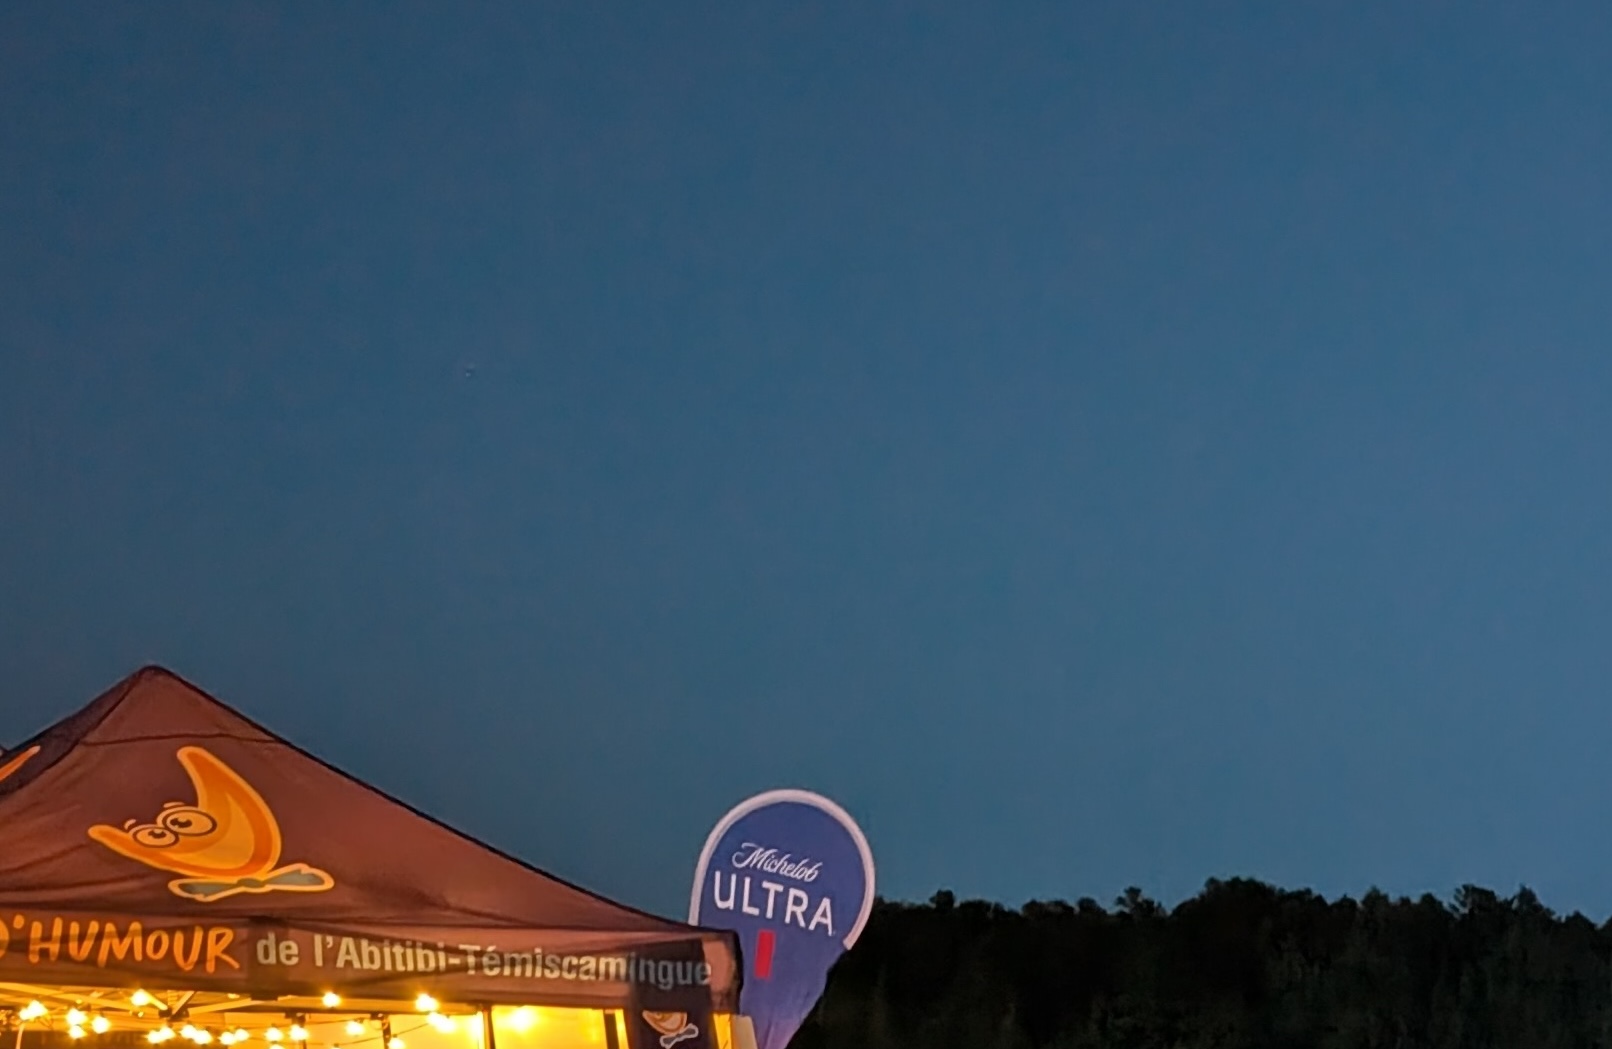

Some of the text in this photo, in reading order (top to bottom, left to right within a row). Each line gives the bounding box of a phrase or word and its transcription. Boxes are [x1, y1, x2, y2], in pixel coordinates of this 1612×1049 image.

[732, 842, 823, 882] Michelob
[714, 870, 834, 936] ULTRA
[256, 931, 299, 965] de
